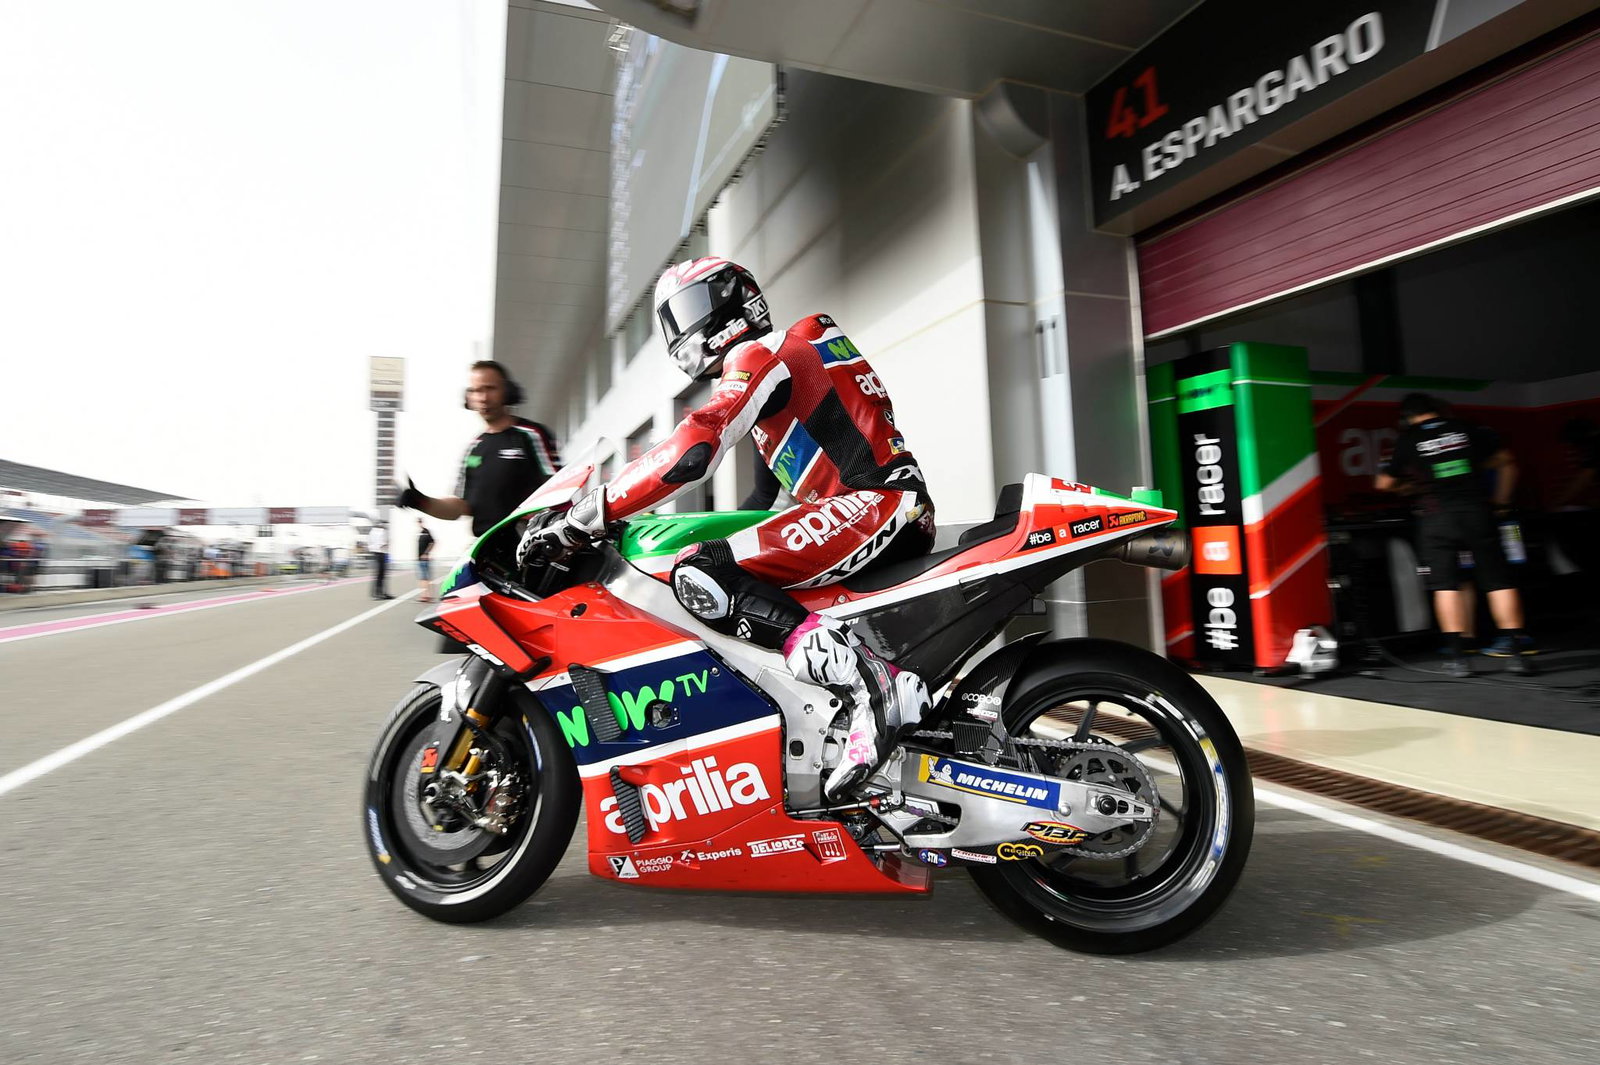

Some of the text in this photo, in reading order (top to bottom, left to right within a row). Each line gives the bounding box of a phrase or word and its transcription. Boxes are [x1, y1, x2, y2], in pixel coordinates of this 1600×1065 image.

[1106, 66, 1168, 139] 41
[1110, 11, 1384, 200] A. ESPARGARO
[1193, 433, 1226, 516] racer
[1029, 519, 1100, 545] #be a racer
[1205, 586, 1239, 650] #be
[676, 669, 708, 697] TV
[600, 755, 771, 834] aprilia
[956, 772, 1049, 801] MICHELIN
[636, 855, 674, 867] PIAGGIO
[697, 847, 742, 861] Experis
[1004, 847, 1036, 856] REGINA
[640, 864, 671, 873] GROUP
